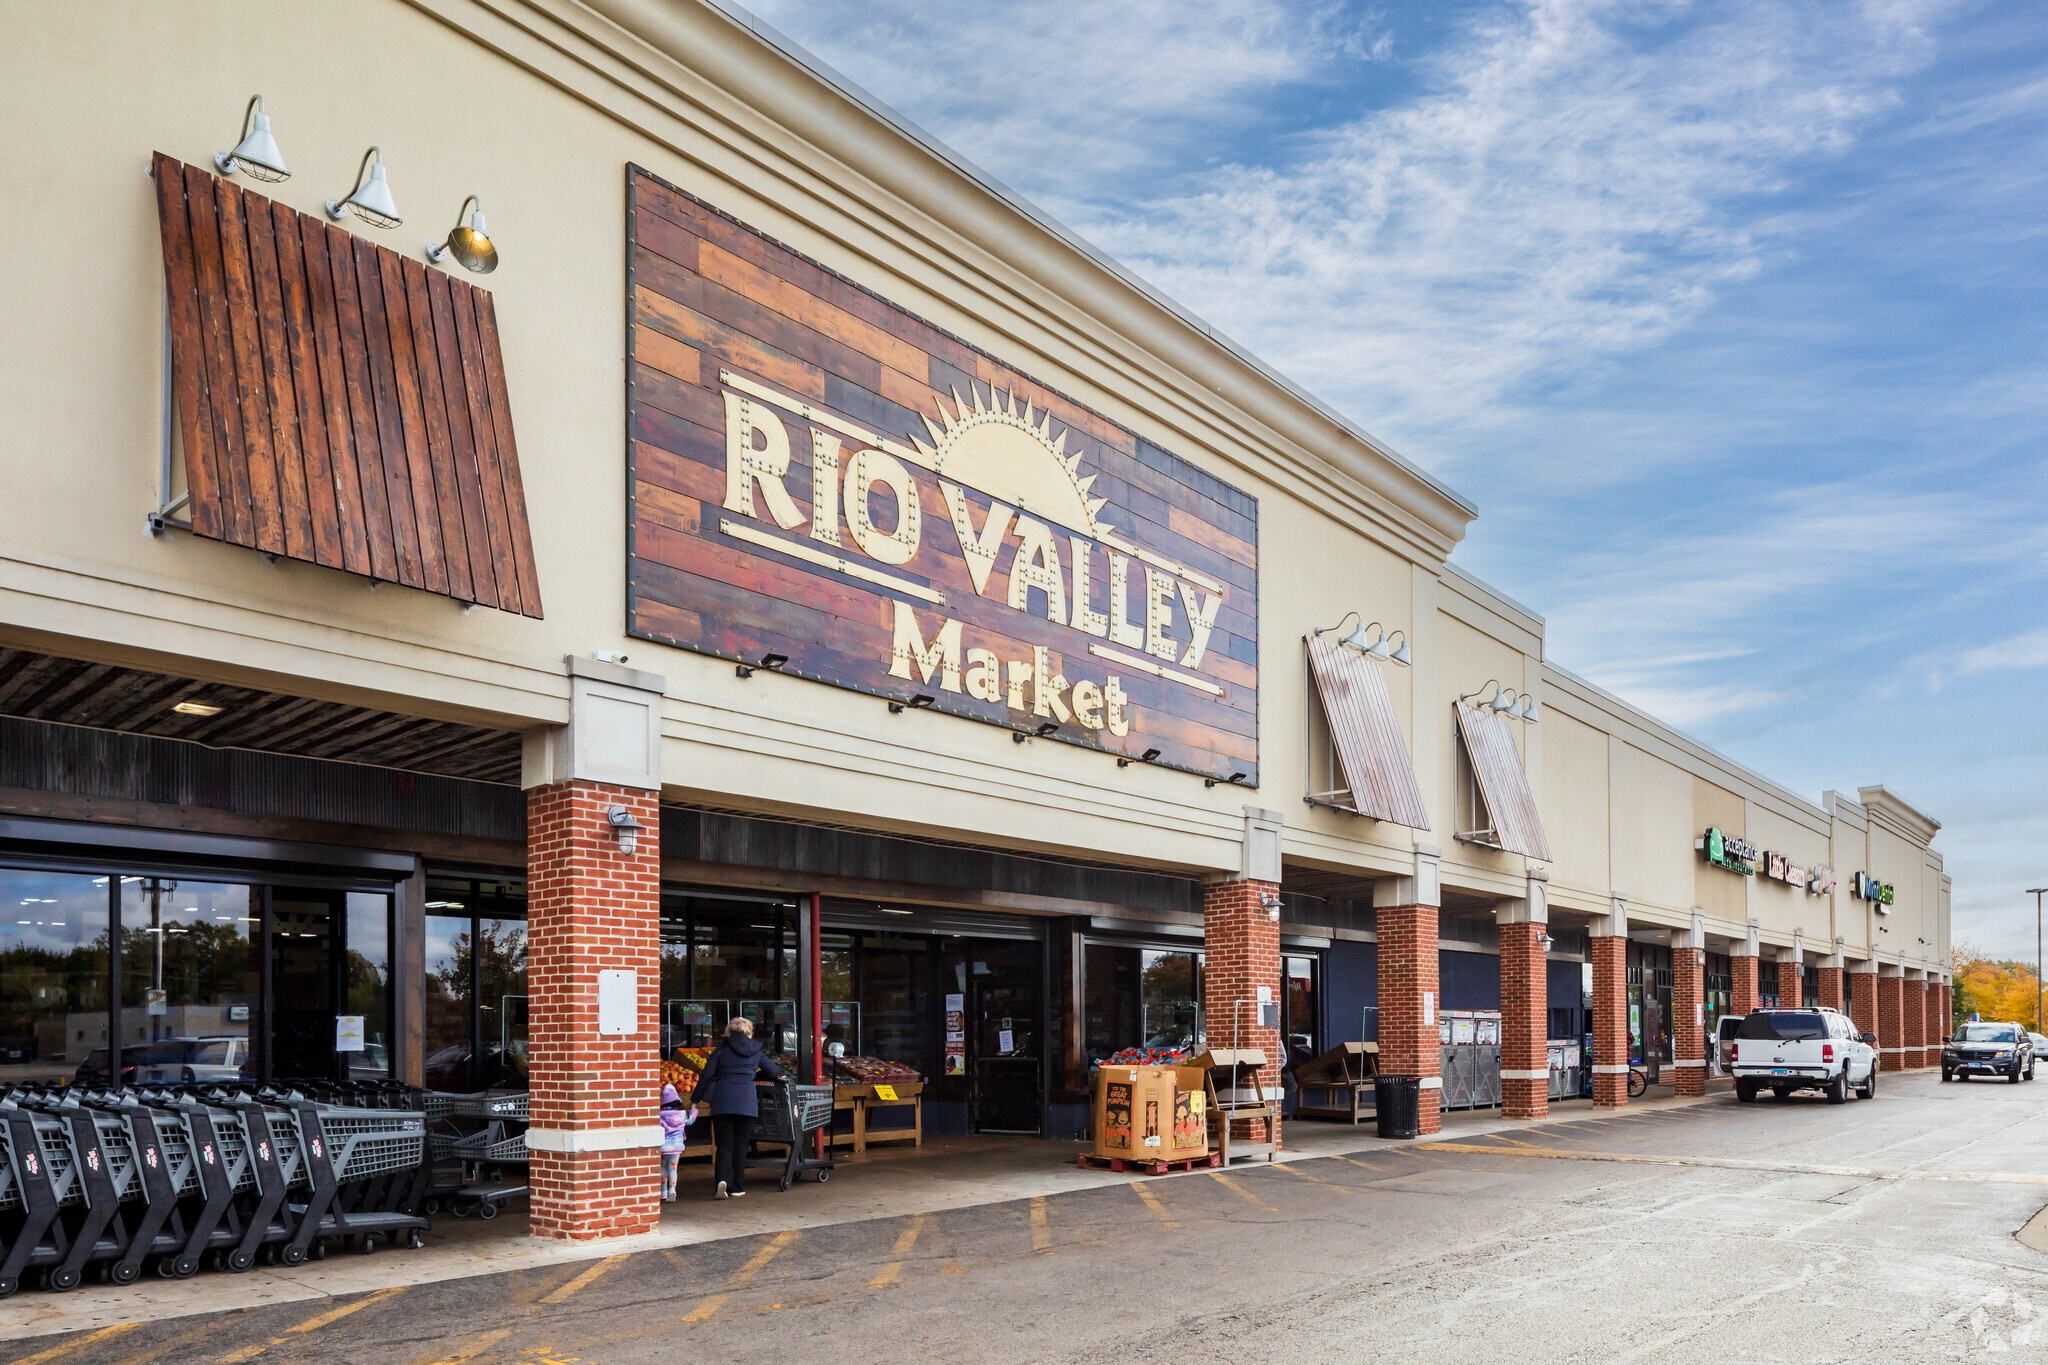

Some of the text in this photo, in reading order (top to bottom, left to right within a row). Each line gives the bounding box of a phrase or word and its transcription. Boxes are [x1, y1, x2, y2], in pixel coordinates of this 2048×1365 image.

[720, 389, 1223, 670] RIO VALLEY
[887, 599, 1129, 737] Market
[1724, 836, 1758, 861] acceptance
[1107, 1098, 1130, 1106] PUMPKIN
[1111, 1091, 1128, 1099] GREAT
